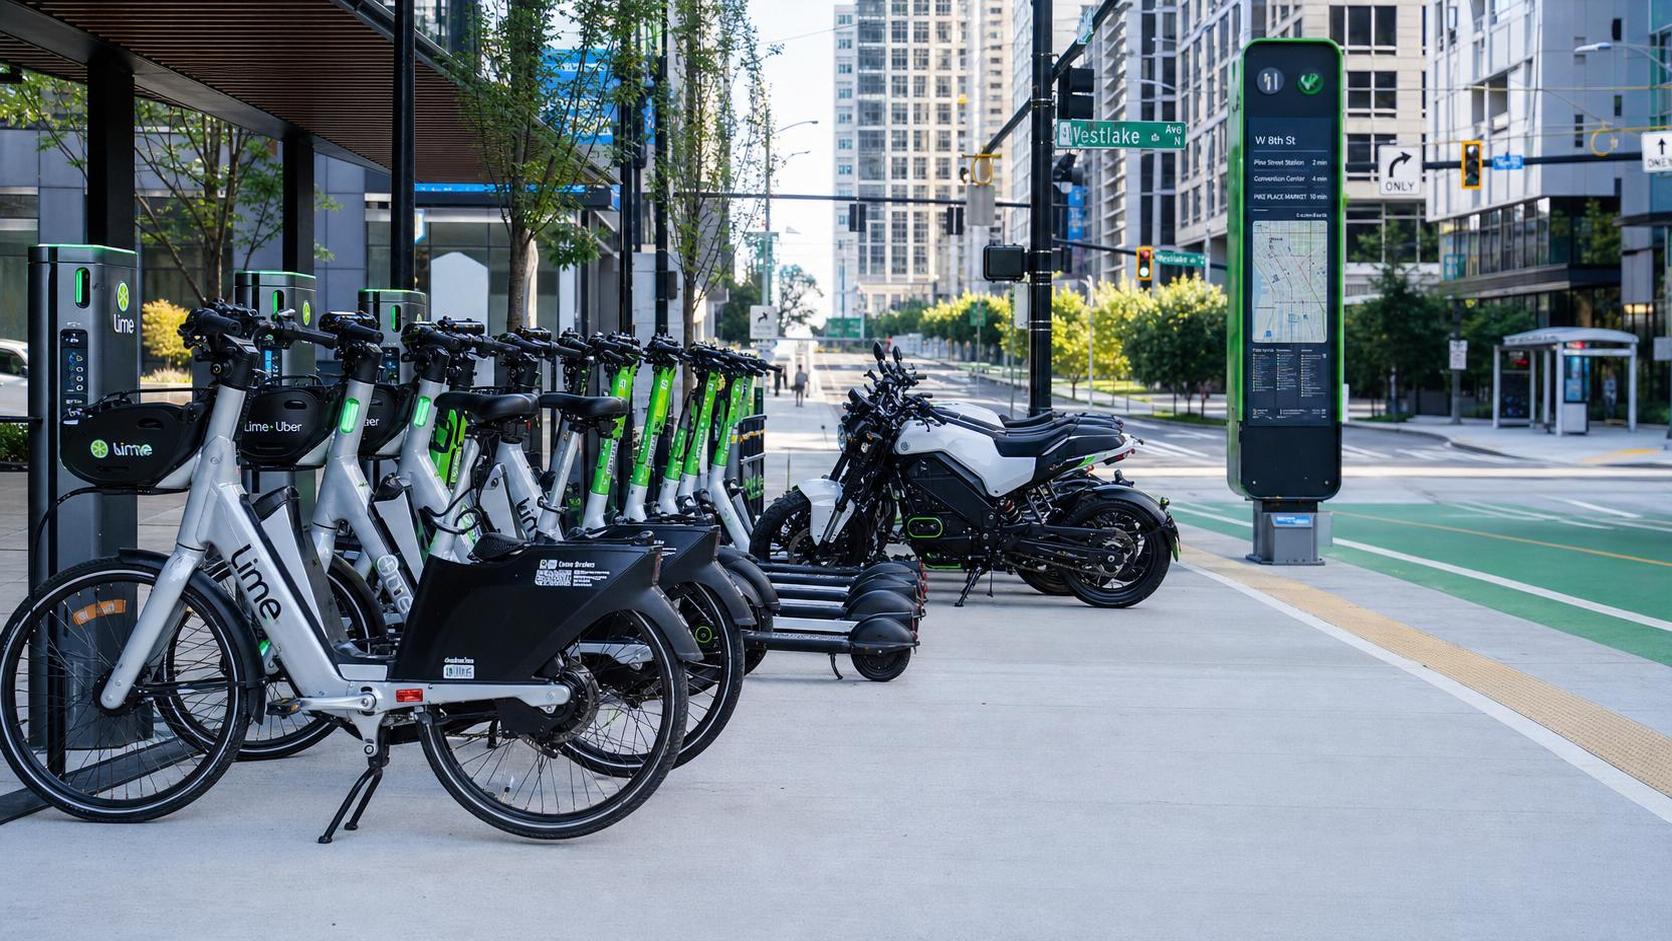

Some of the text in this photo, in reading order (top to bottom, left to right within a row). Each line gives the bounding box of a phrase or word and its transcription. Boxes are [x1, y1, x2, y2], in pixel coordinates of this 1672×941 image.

[1174, 137, 1181, 146] N
[1255, 135, 1297, 145] W 8th St
[1385, 181, 1416, 192] ONLY
[113, 313, 135, 334] Lime
[244, 421, 303, 432] Lime Uber
[230, 543, 282, 620] Lime
